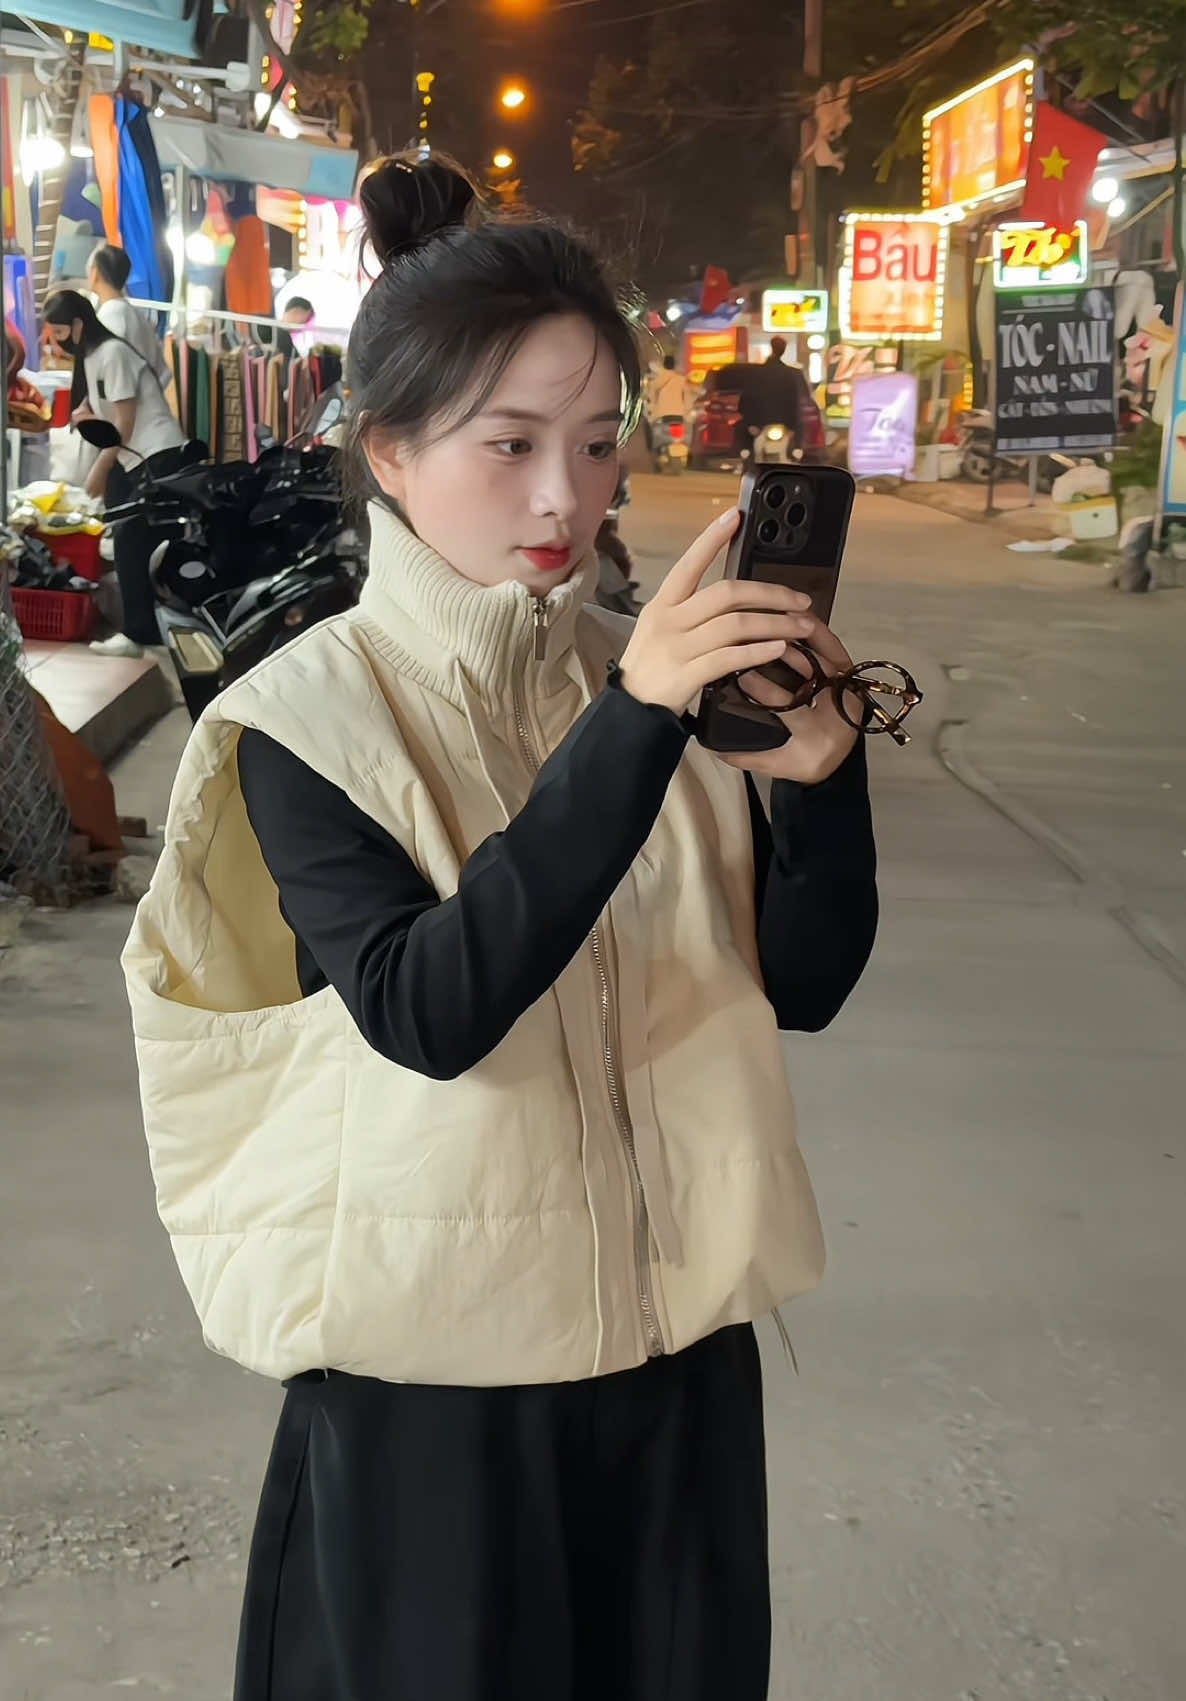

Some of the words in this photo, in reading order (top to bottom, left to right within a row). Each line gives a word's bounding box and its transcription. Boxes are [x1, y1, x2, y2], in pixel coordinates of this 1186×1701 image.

[999, 314, 1044, 369] TÓC
[1057, 320, 1113, 366] NAIL
[1013, 374, 1059, 395] NAM
